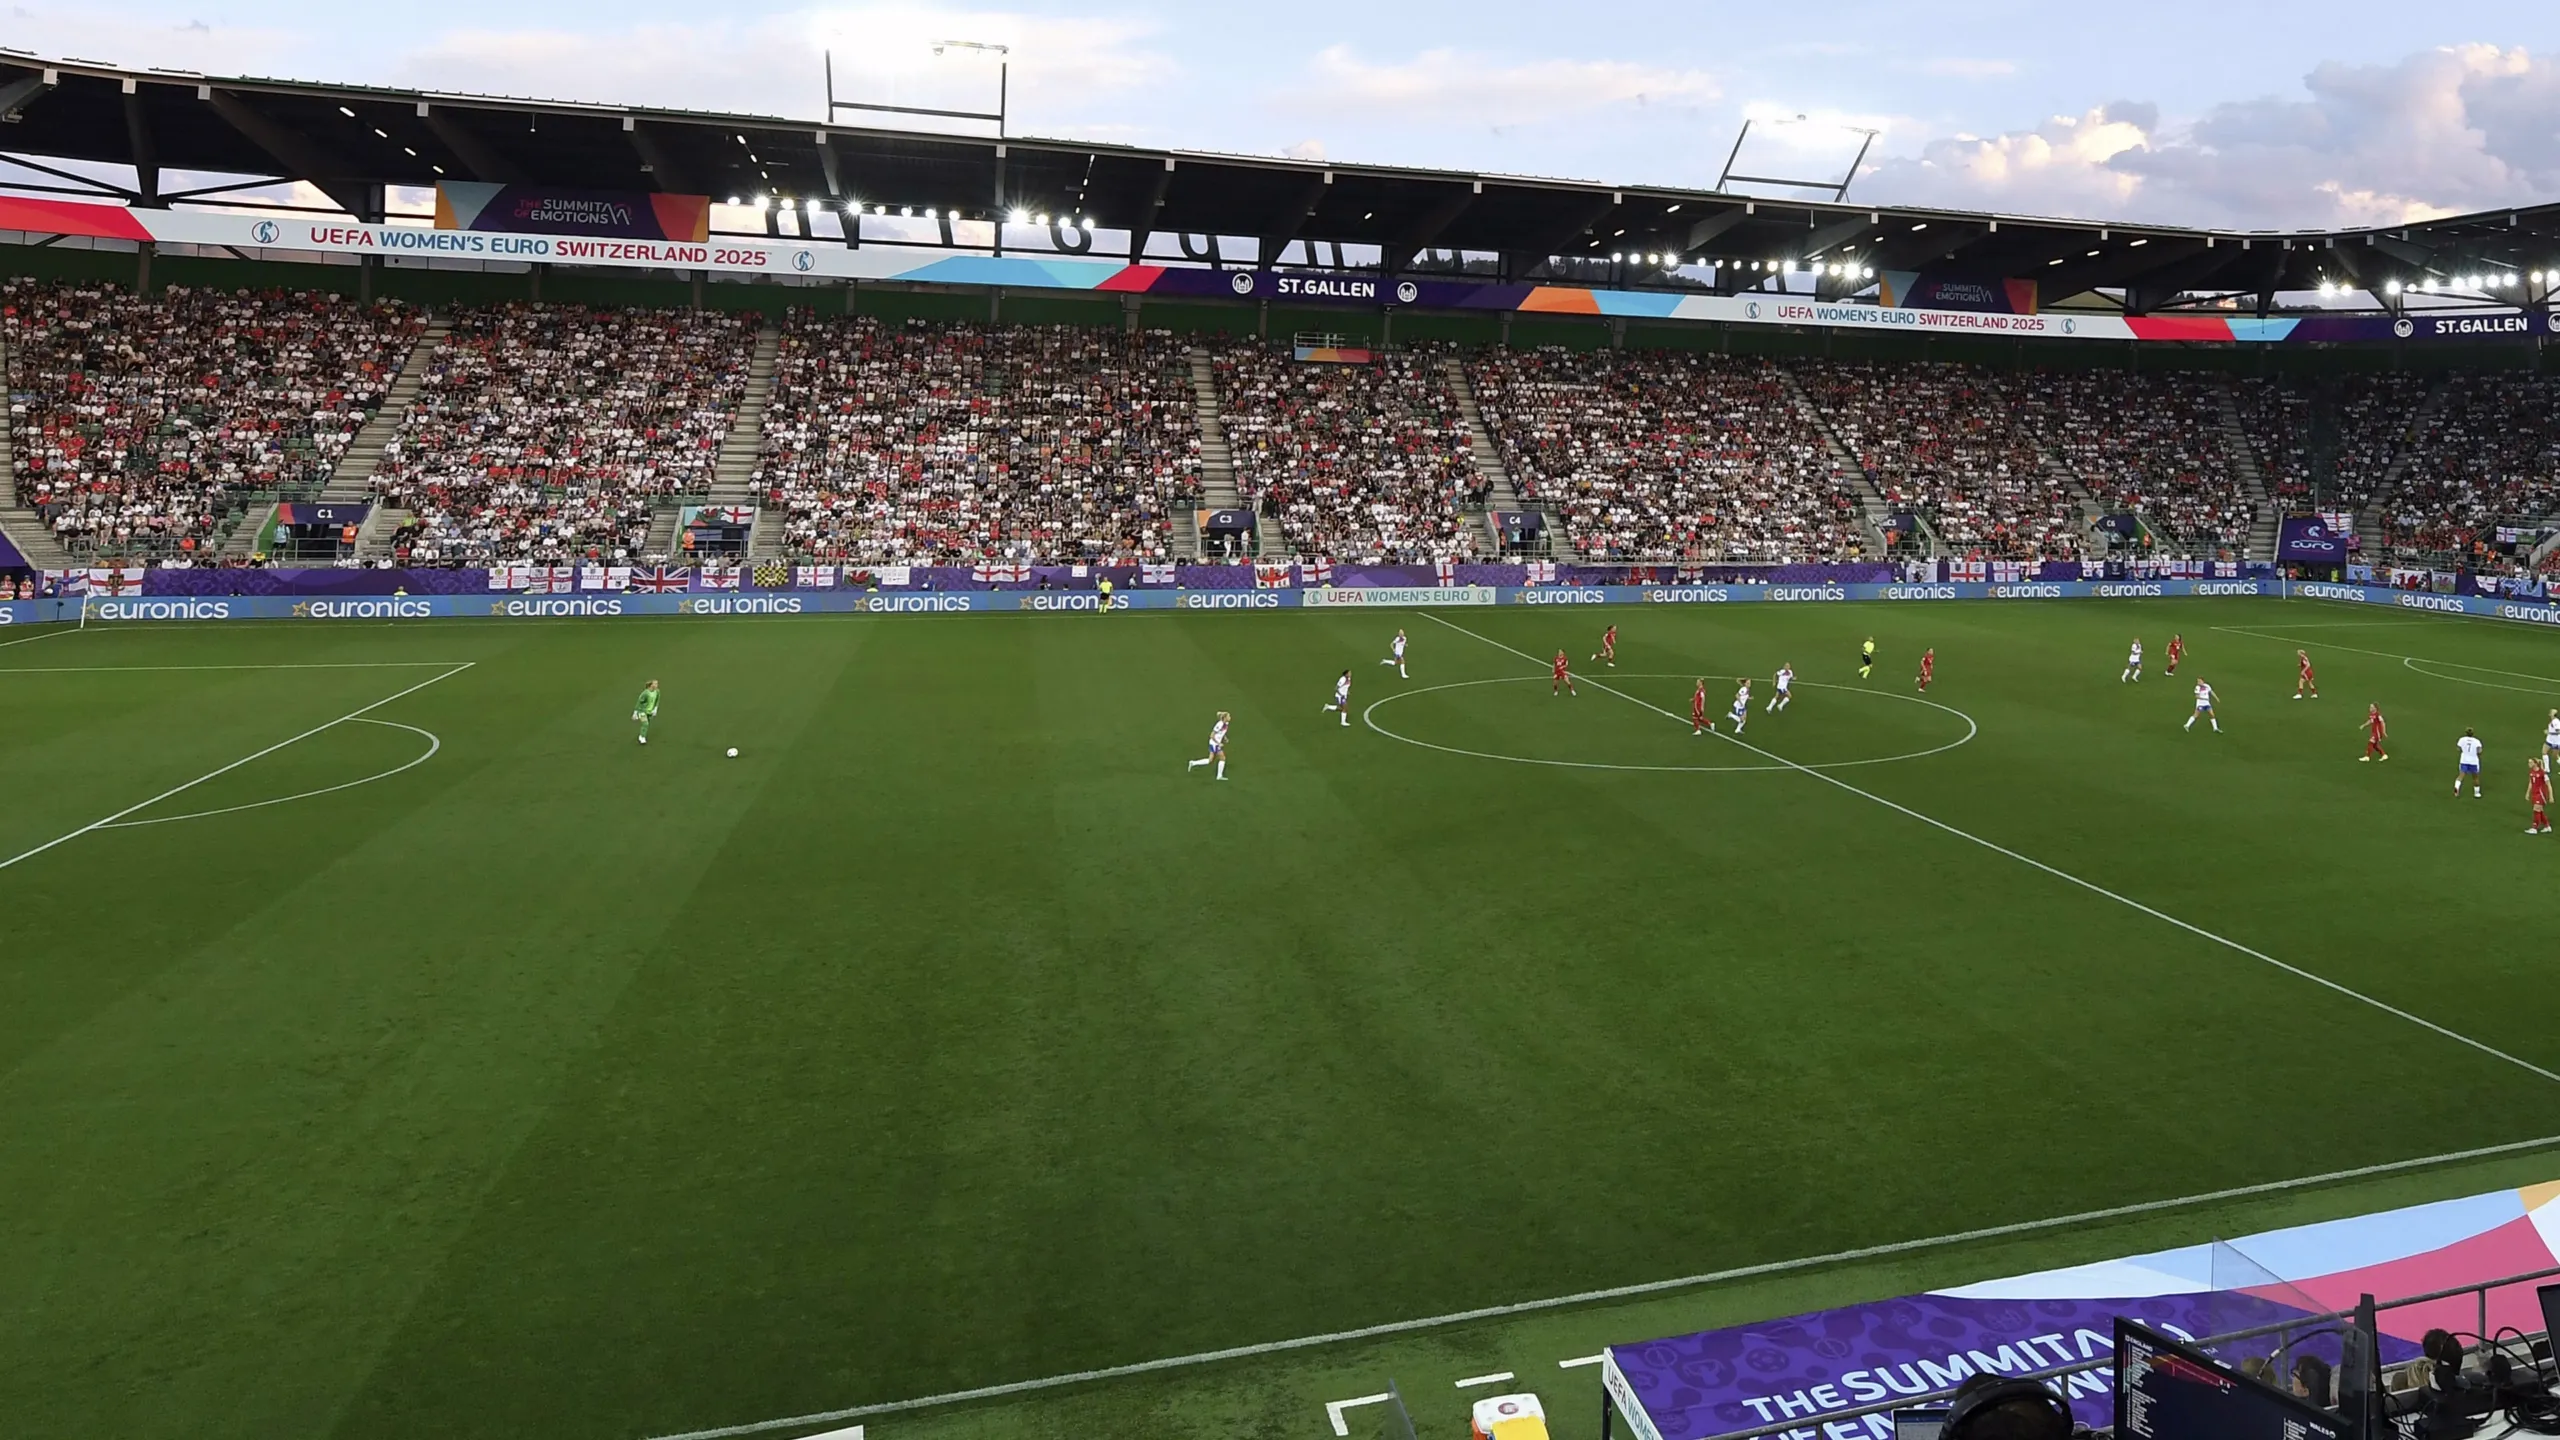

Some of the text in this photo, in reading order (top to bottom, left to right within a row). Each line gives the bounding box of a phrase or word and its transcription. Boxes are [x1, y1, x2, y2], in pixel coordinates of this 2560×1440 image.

[530, 209, 609, 225] EMOTIONS
[311, 227, 374, 246] UEFA
[379, 231, 484, 252] WOMEN'S
[490, 238, 549, 255] EURO
[556, 240, 708, 263] SWITZERLAND
[1278, 278, 1375, 298] ST.GALLEN
[1777, 305, 1814, 319] UEFA
[1816, 307, 1878, 322] WOMEN'S
[1881, 311, 1916, 325] EURO
[1919, 313, 2008, 329] SWITZERLAND
[2434, 317, 2528, 335] ST.GALLEN
[317, 508, 334, 519] C1
[1327, 590, 1470, 602] UEFA WOMEN'S EURO
[1525, 584, 1604, 605] euronics
[1652, 583, 1728, 603] euronics
[1773, 582, 1845, 601] euronics
[1887, 583, 1956, 600] euronics
[1996, 582, 2061, 598] euronics
[2100, 581, 2161, 597] euronics
[2198, 580, 2258, 596] euronics
[2303, 584, 2365, 602] euronics
[100, 597, 229, 620] euronics
[310, 596, 431, 618] euronics
[507, 595, 622, 616] euronics
[693, 592, 802, 614] euronics
[868, 592, 970, 612] euronics
[1033, 593, 1129, 612] euroncs
[1188, 590, 1279, 609] euronics
[2402, 593, 2464, 613] euronics
[1743, 1383, 1849, 1422] THE
[1841, 1333, 2074, 1402] SUMMIT
[1608, 1365, 1655, 1440] UEFA WOME
